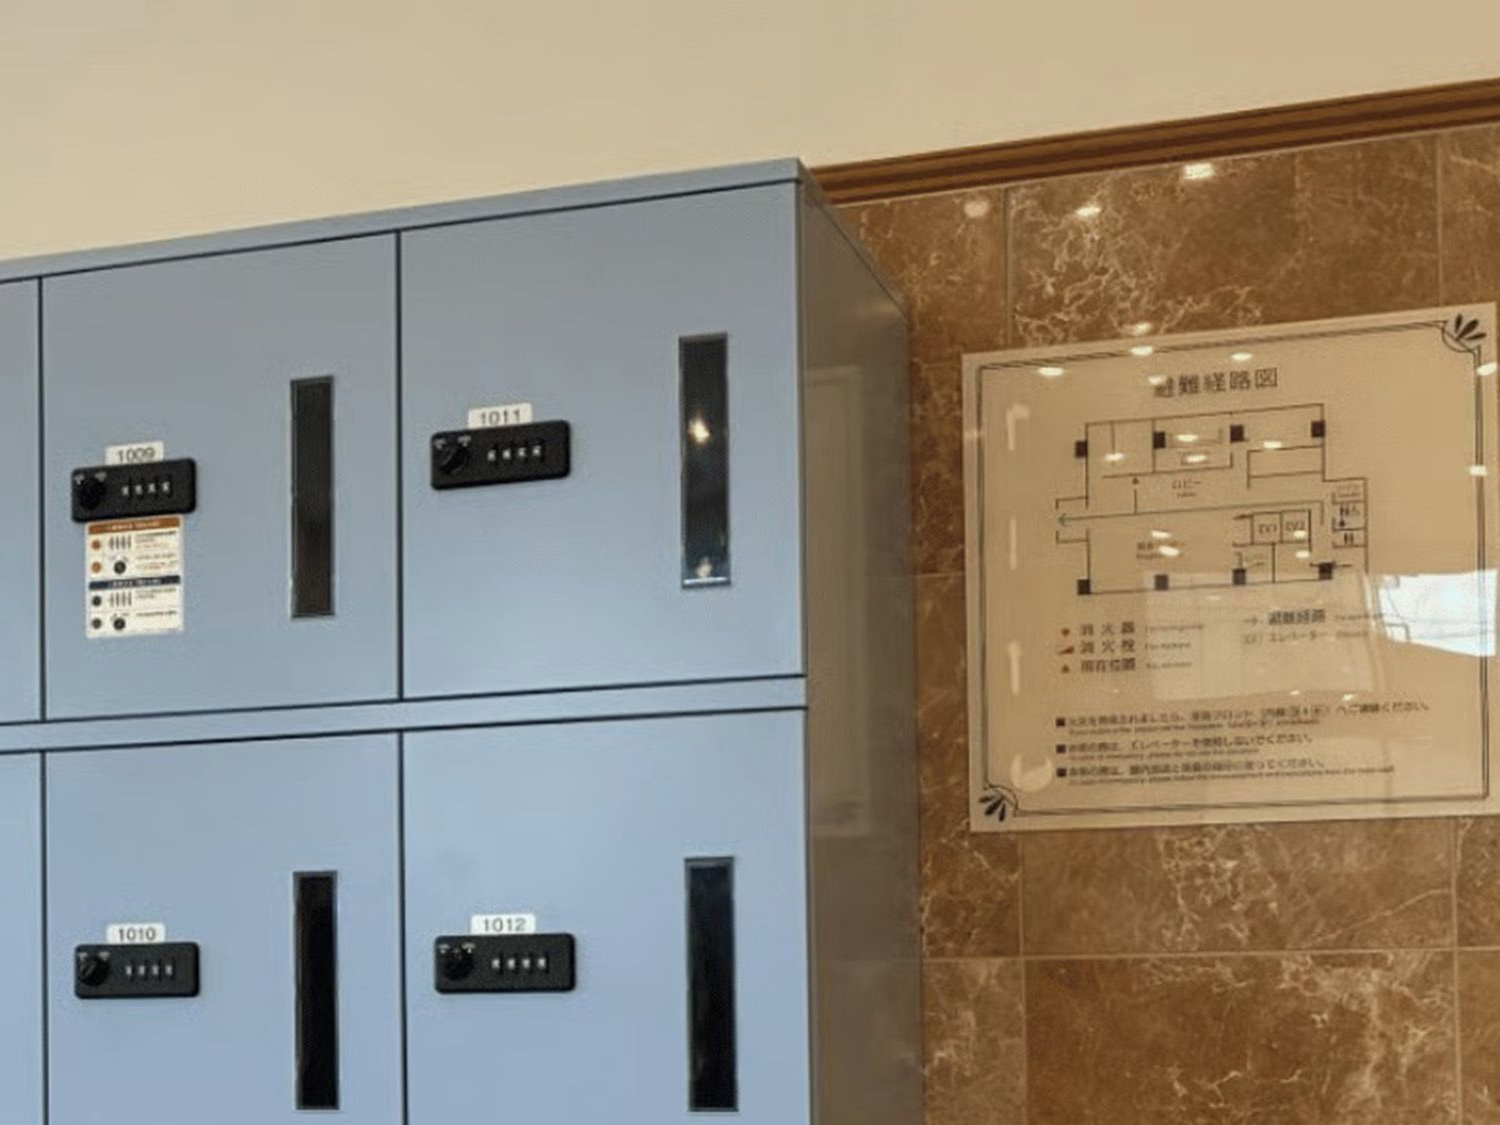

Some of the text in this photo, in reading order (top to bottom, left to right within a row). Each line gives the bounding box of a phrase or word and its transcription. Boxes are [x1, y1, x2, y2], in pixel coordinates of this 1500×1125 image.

[1152, 367, 1278, 398] 避難経路図
[479, 409, 521, 426] 1011
[116, 447, 156, 463] 1009
[482, 917, 527, 933] 1012
[116, 927, 157, 941] 1010
